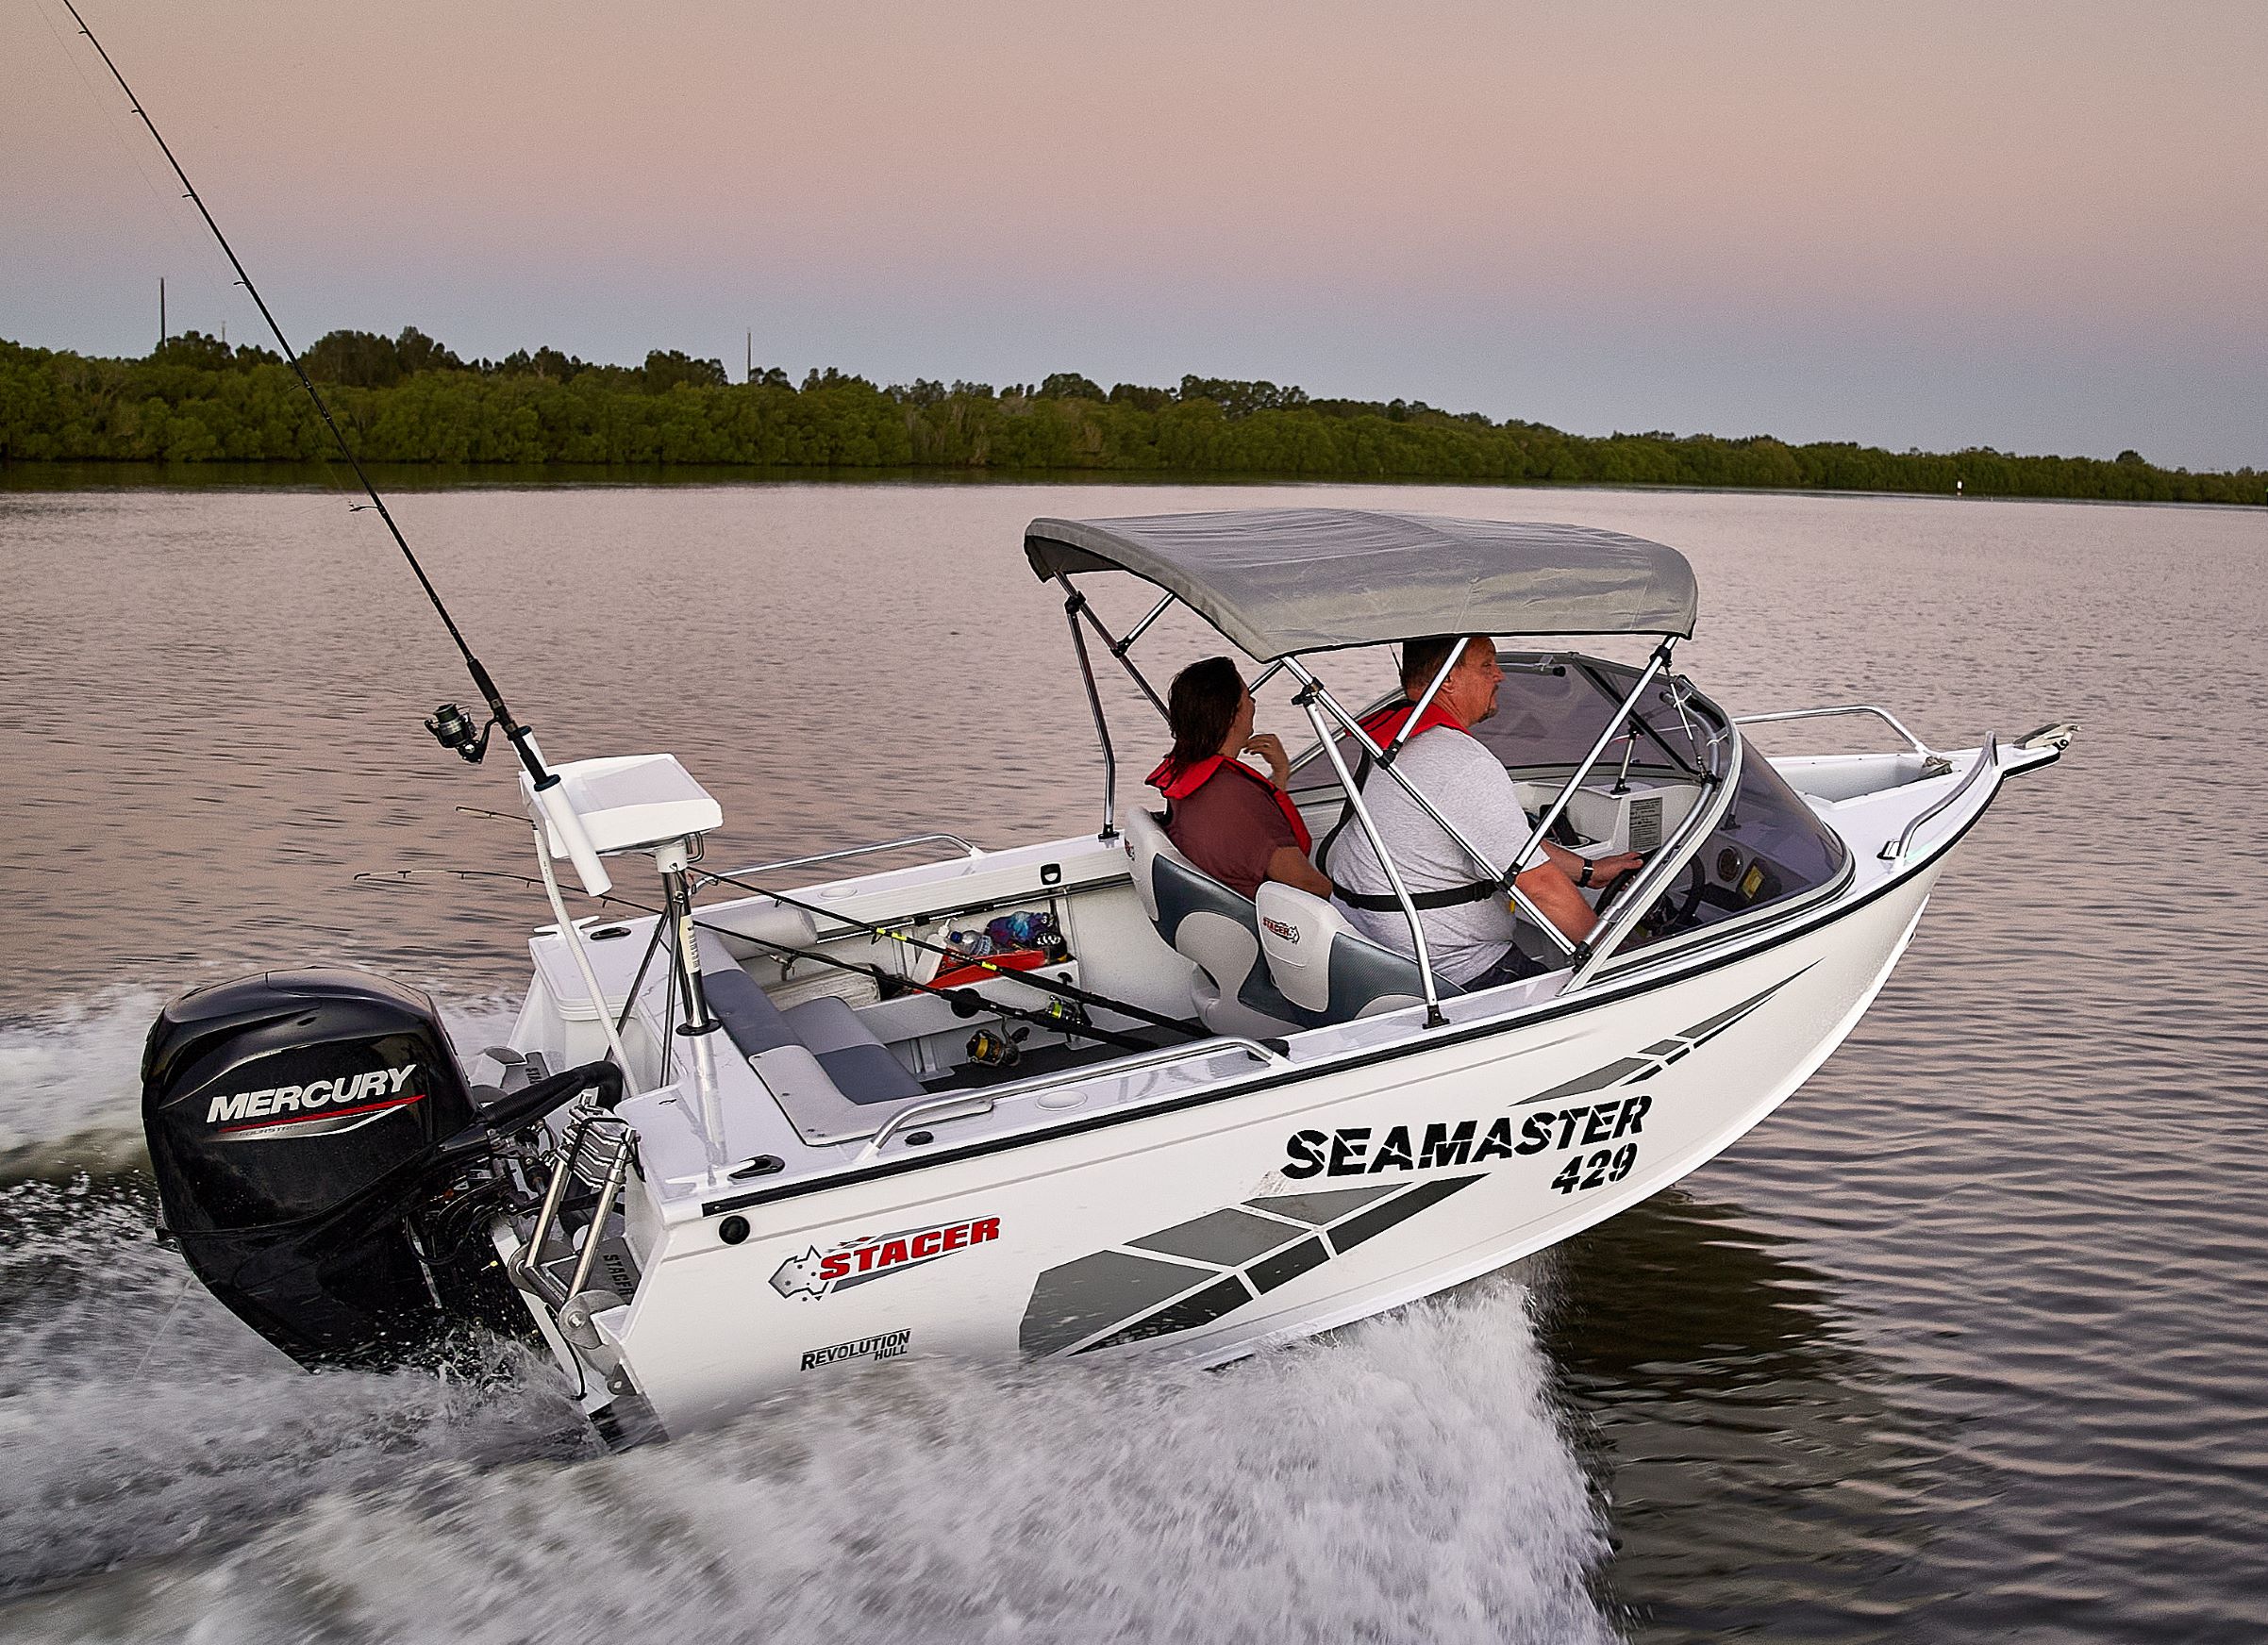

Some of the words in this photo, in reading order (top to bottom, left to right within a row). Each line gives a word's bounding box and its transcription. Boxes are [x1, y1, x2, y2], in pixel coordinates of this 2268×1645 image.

[1262, 917, 1290, 936] STACER
[207, 1064, 417, 1122] MERCURY
[1280, 1095, 1653, 1179] SEAMASTER
[1551, 1142, 1637, 1194] 429
[819, 1217, 1000, 1281] STACER
[800, 1330, 911, 1371] REVOLUTION
[874, 1345, 908, 1360] HULL
